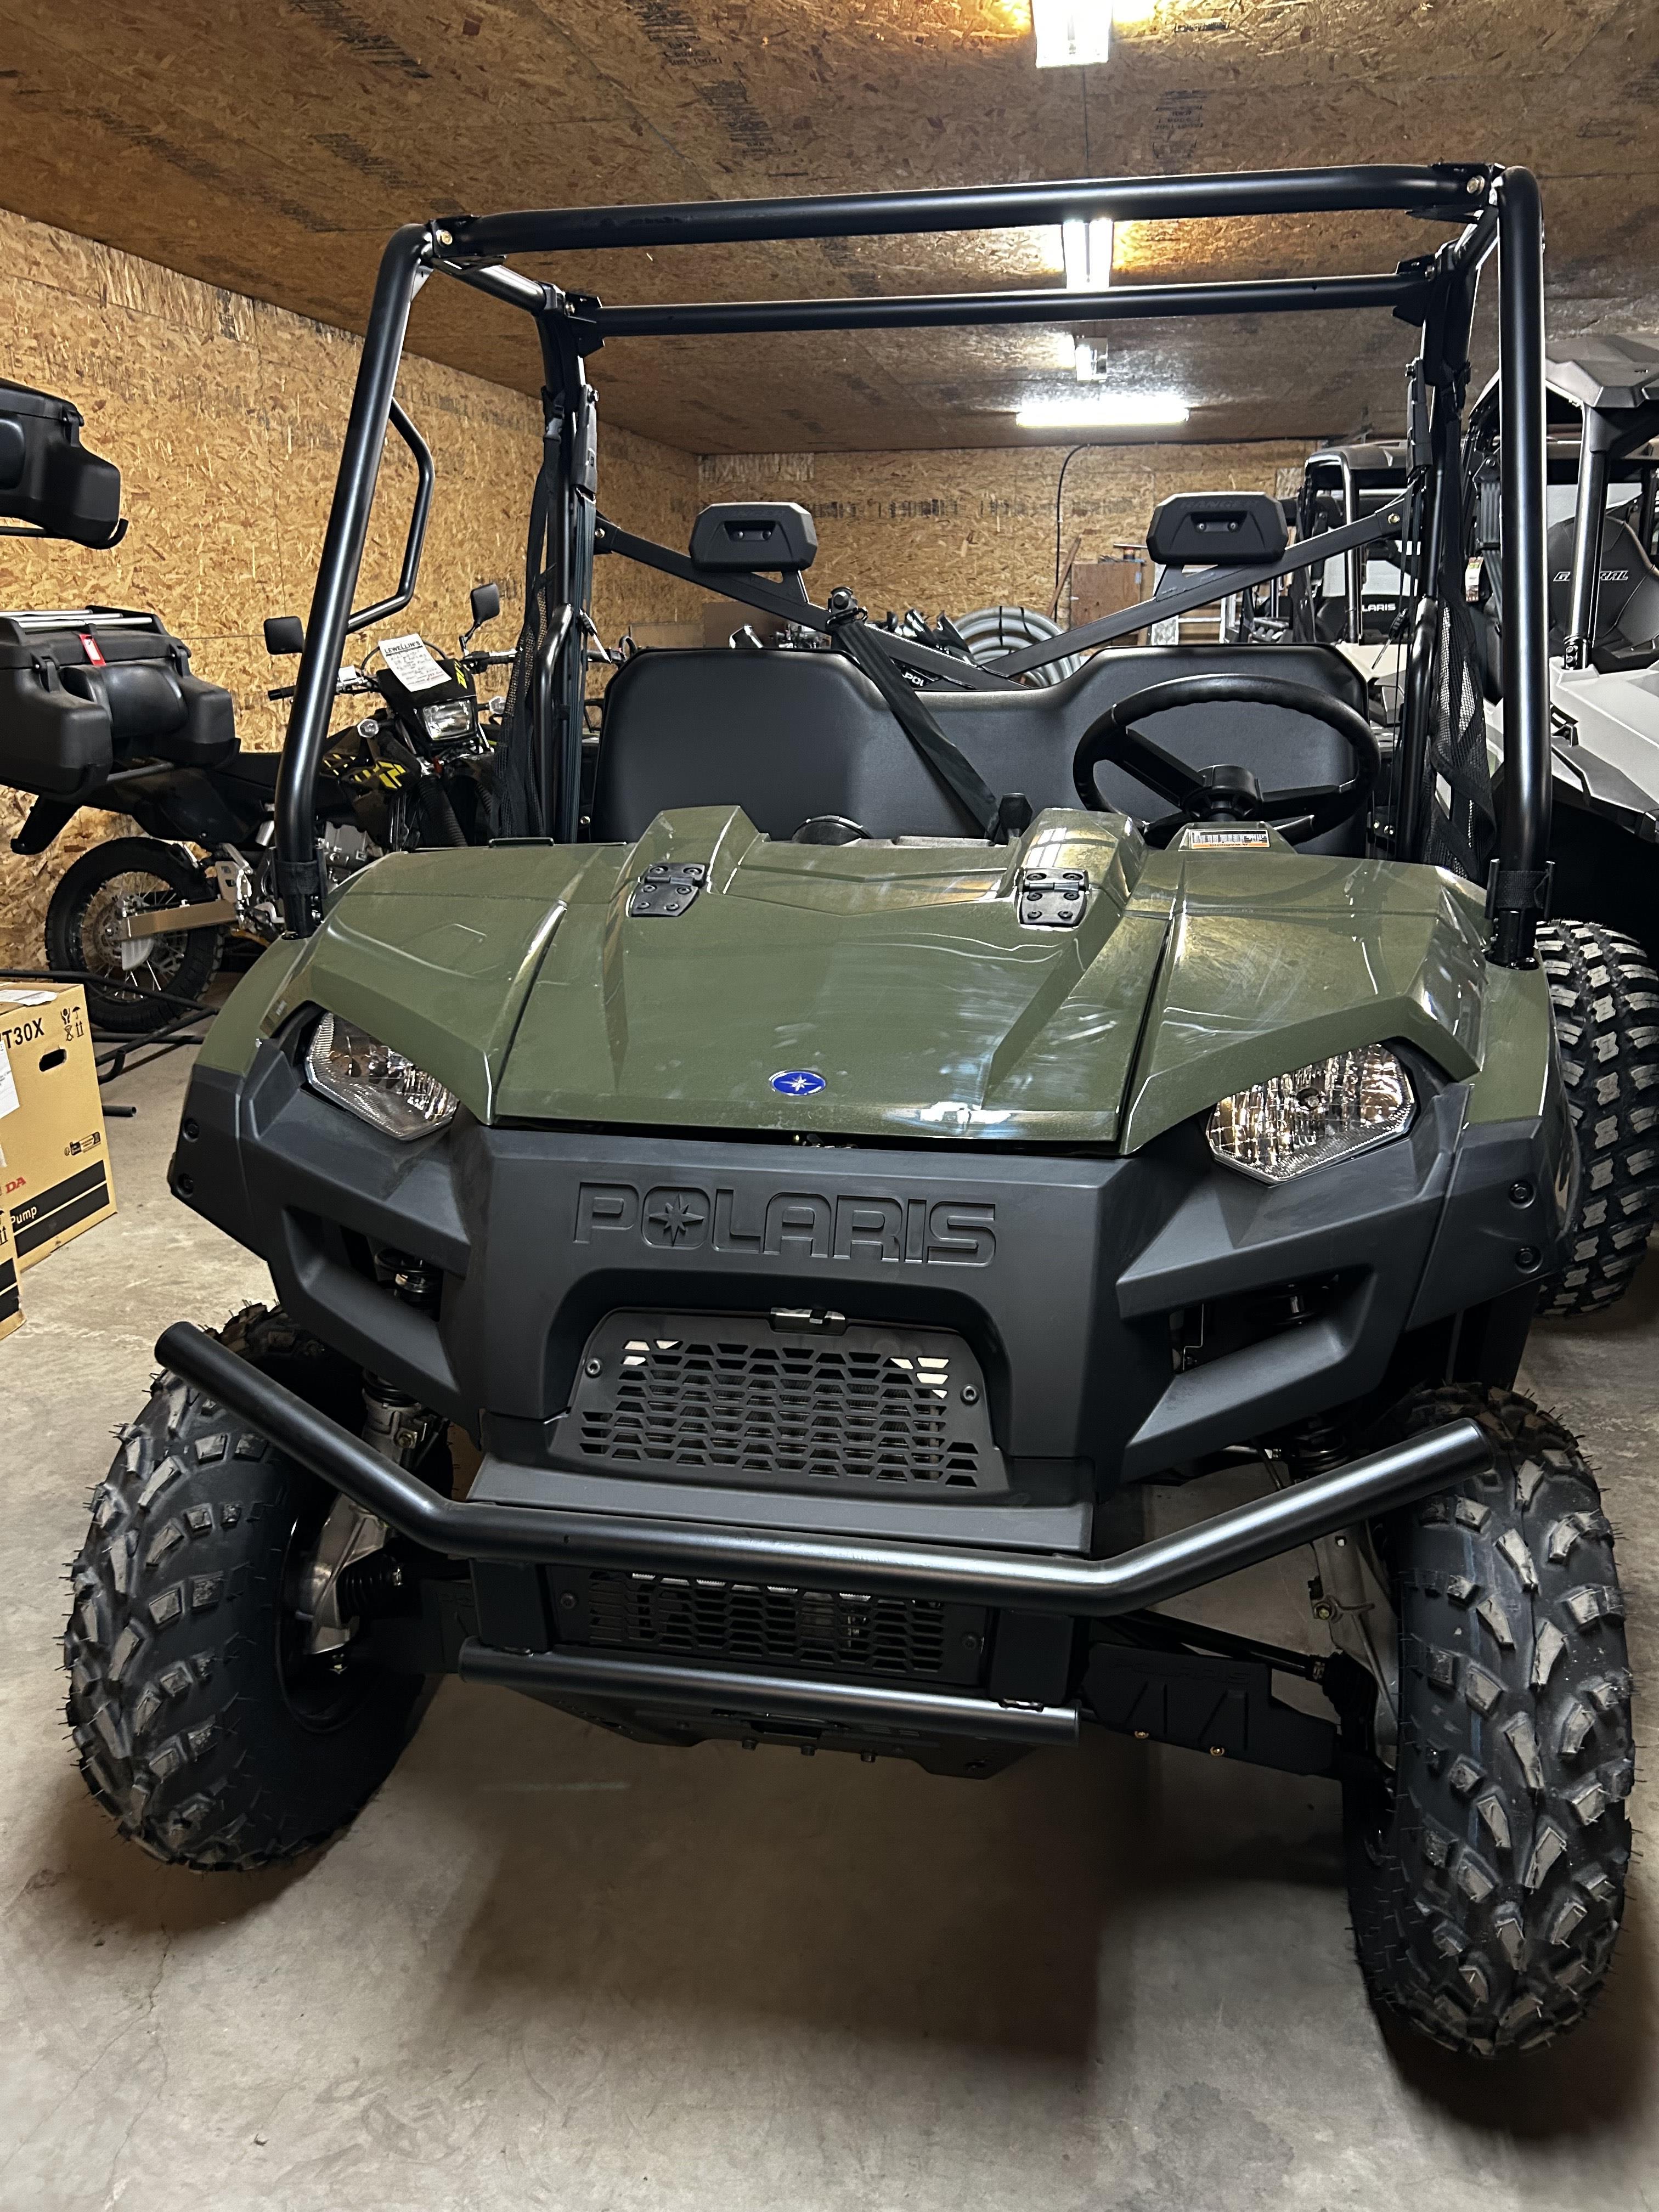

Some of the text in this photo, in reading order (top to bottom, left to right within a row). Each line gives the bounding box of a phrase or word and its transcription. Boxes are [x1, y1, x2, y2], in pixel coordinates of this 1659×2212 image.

[1553, 571, 1628, 582] GRAL
[1362, 603, 1396, 612] LARIS
[0, 1018, 44, 1049] T30X
[11, 1206, 37, 1224] Pump
[573, 1181, 997, 1267] POLARIS
